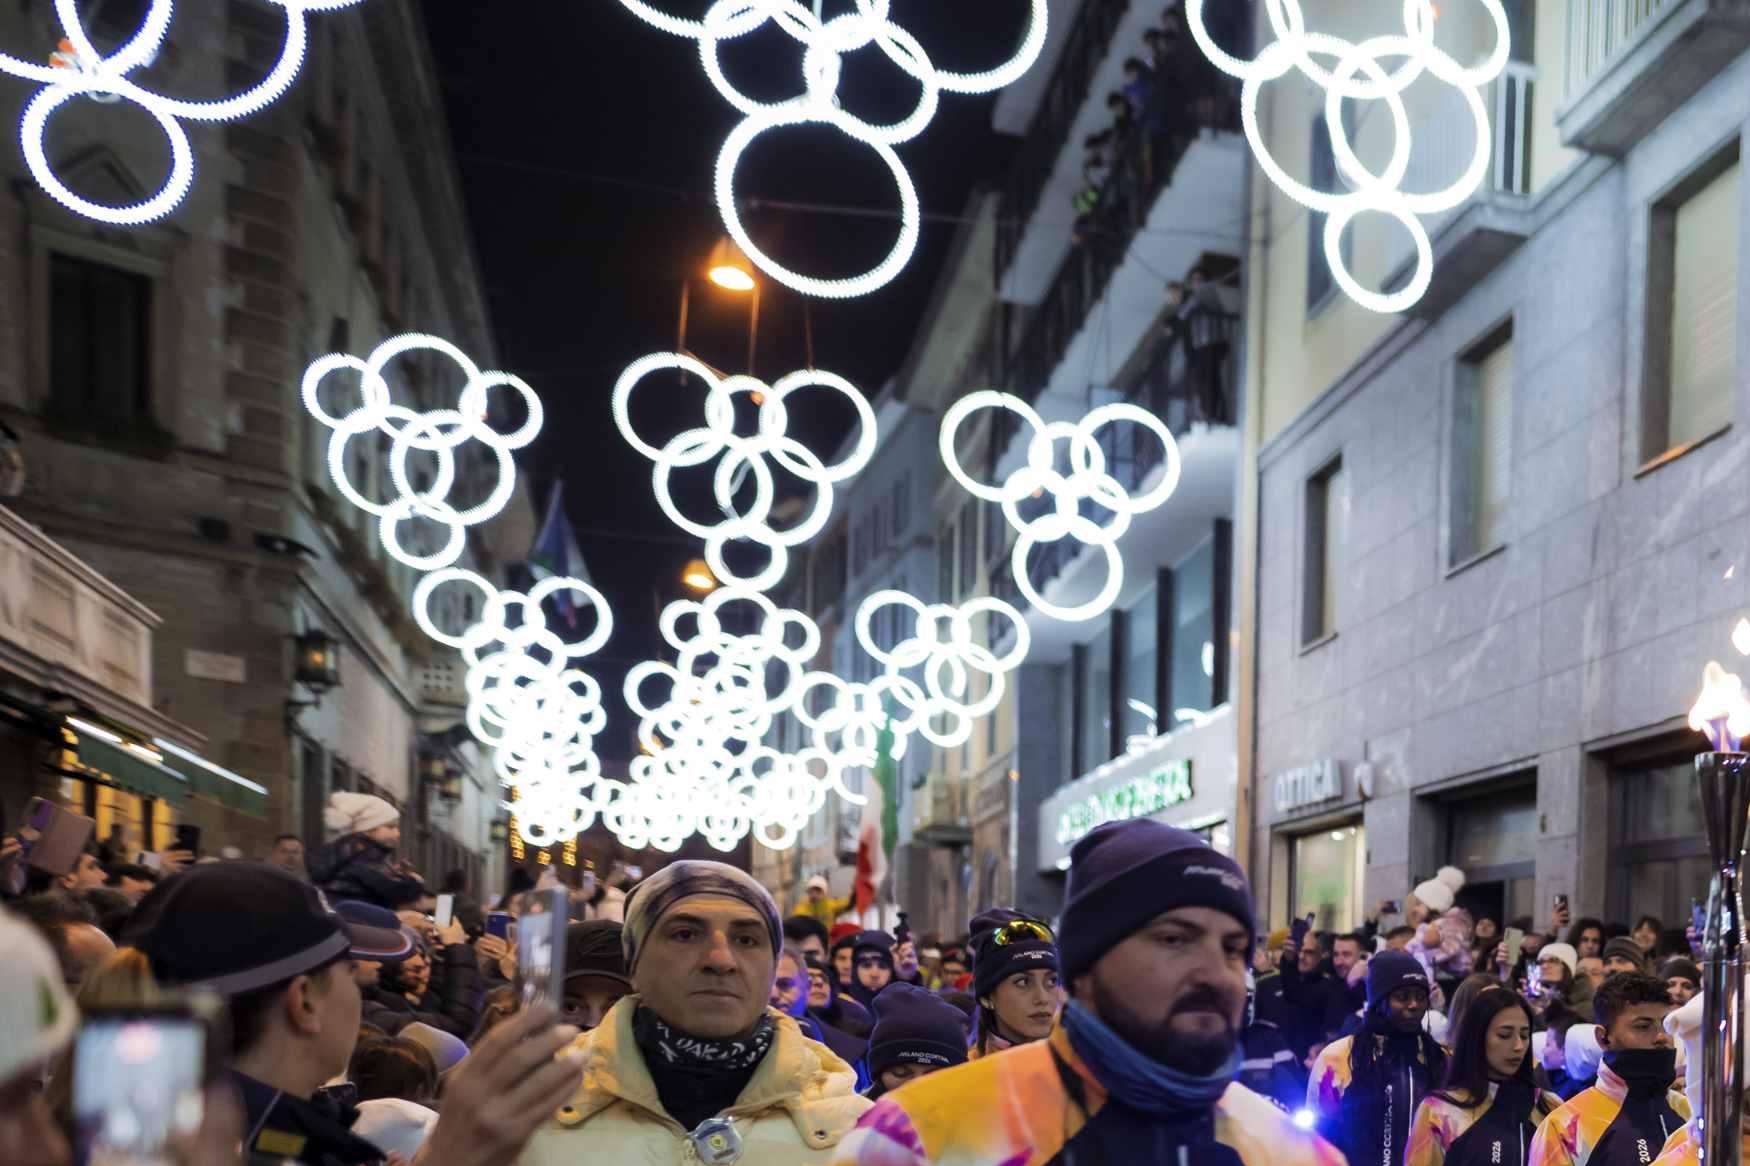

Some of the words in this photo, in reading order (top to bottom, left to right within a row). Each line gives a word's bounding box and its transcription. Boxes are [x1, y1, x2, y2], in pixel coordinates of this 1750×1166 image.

[1273, 758, 1338, 813] OTTICA
[924, 1052, 950, 1064] CORTINA
[1491, 1140, 1502, 1164] 2026
[1636, 1138, 1651, 1163] 2026
